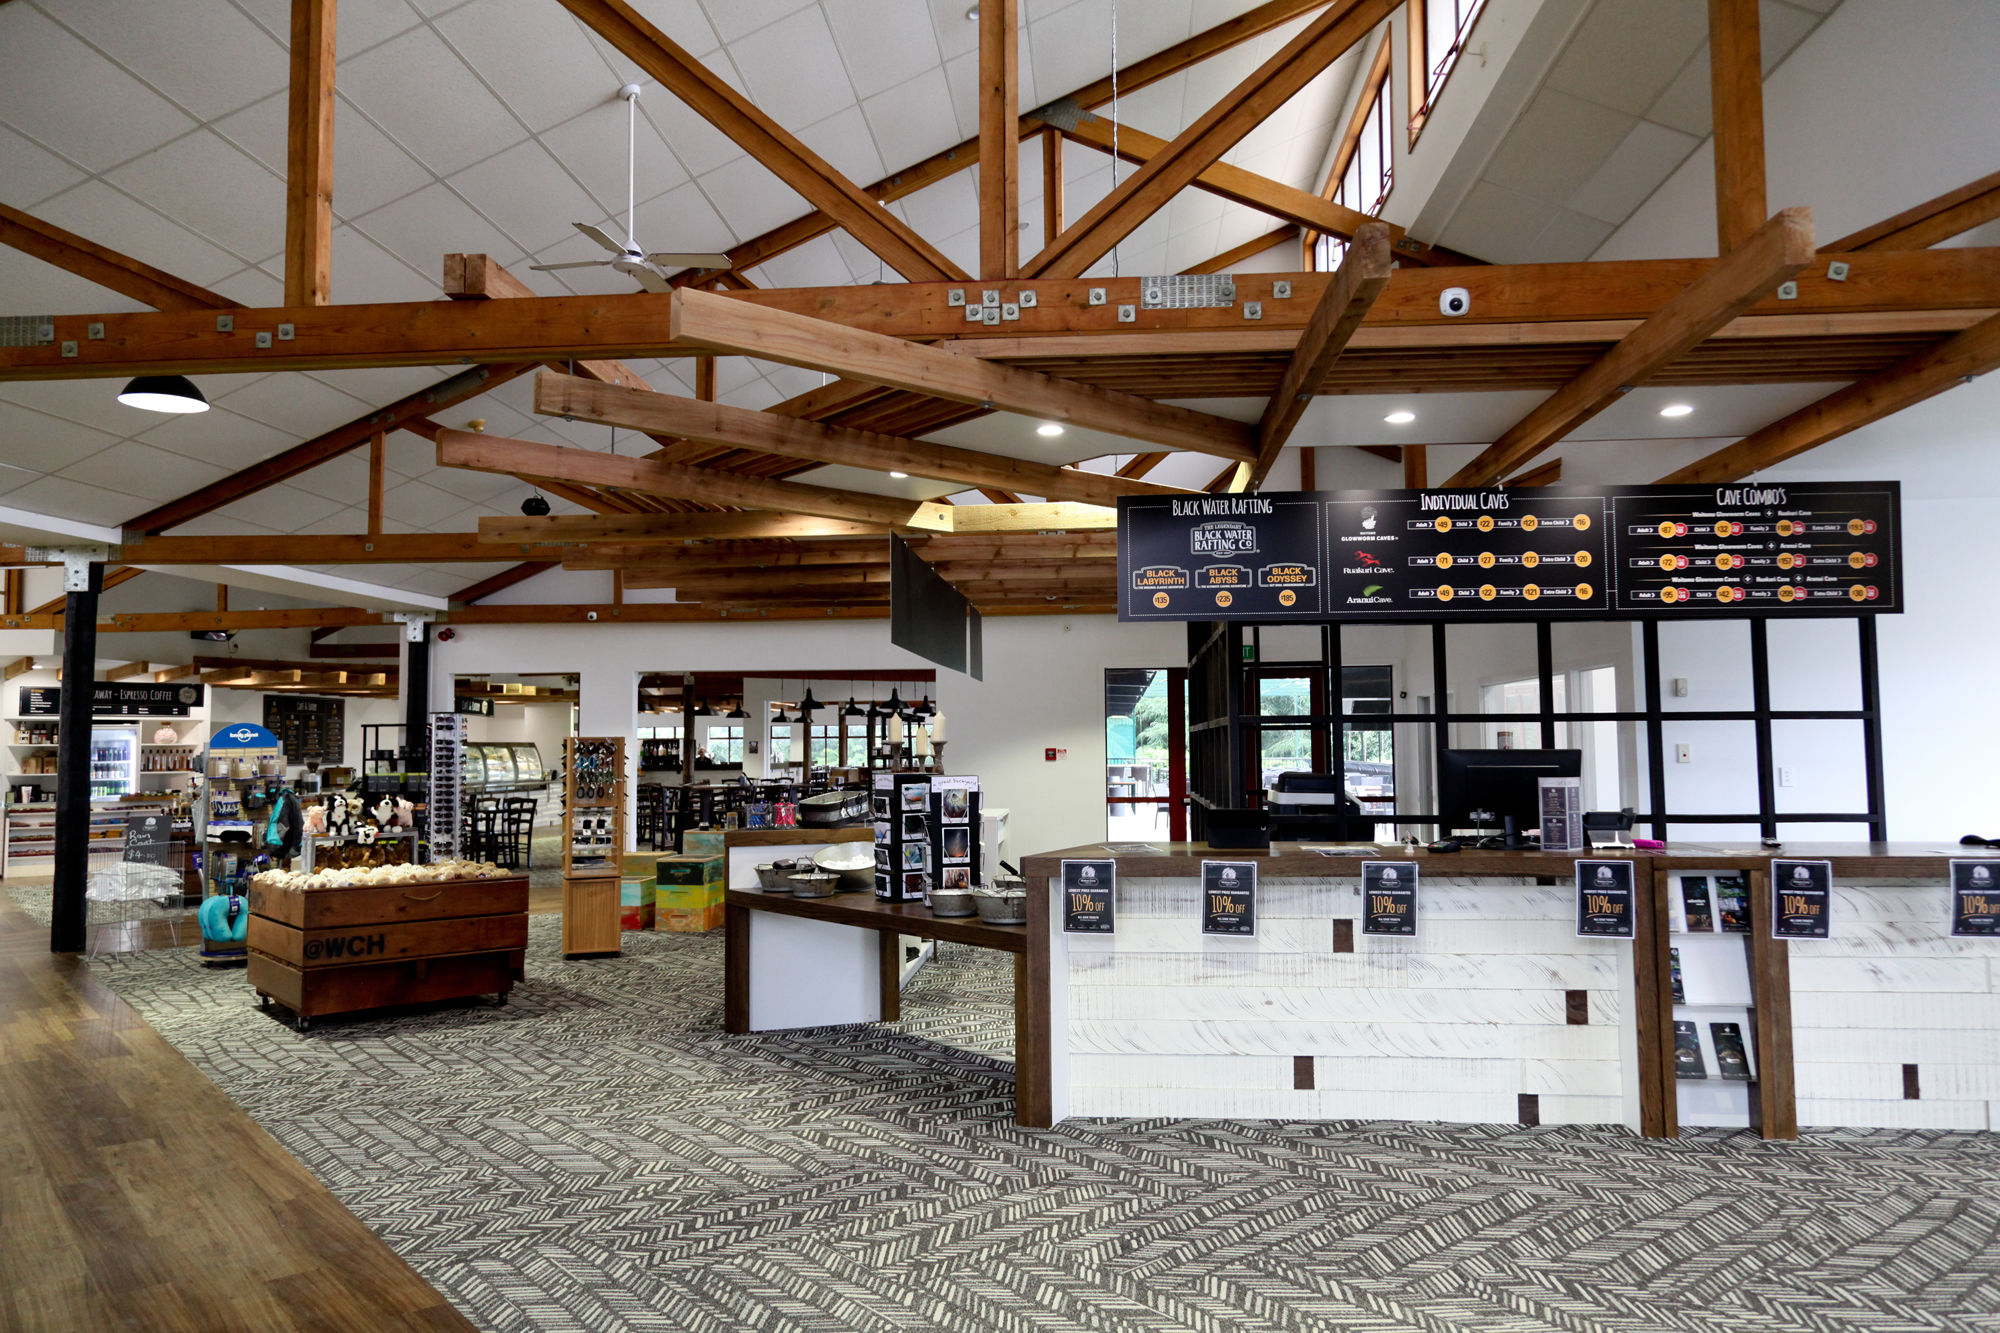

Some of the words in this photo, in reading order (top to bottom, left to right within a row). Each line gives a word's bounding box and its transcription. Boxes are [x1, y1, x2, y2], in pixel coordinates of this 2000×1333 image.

[1421, 494, 1479, 510] INDIVIDUAL
[1480, 492, 1509, 510] CAVES
[1716, 488, 1742, 505] CAVE
[1743, 488, 1786, 505] COMBO'S
[1172, 500, 1200, 516] BLACK
[1202, 498, 1230, 515] WATER
[1232, 497, 1272, 515] RAFTING
[1194, 530, 1222, 540] BLACK
[1224, 530, 1252, 540] WATER
[1195, 540, 1235, 550] RAFTING
[1147, 570, 1175, 578] BLACK
[1267, 575, 1307, 583] ODYSSEY
[120, 689, 147, 700] ESPRESSO
[150, 689, 172, 701] COFFEE
[1072, 893, 1094, 911] 10%
[1096, 902, 1104, 911] OFF
[1211, 895, 1234, 913] 10%
[1236, 904, 1246, 914] OFF
[1372, 895, 1395, 913] 10%
[1397, 904, 1407, 913] OFF
[1587, 895, 1612, 913] 10%
[1613, 904, 1623, 913] OFF
[1783, 895, 1808, 914] 10%
[1809, 905, 1820, 914] OFF
[1962, 896, 1988, 914] 10%
[304, 934, 384, 959] @WCH
